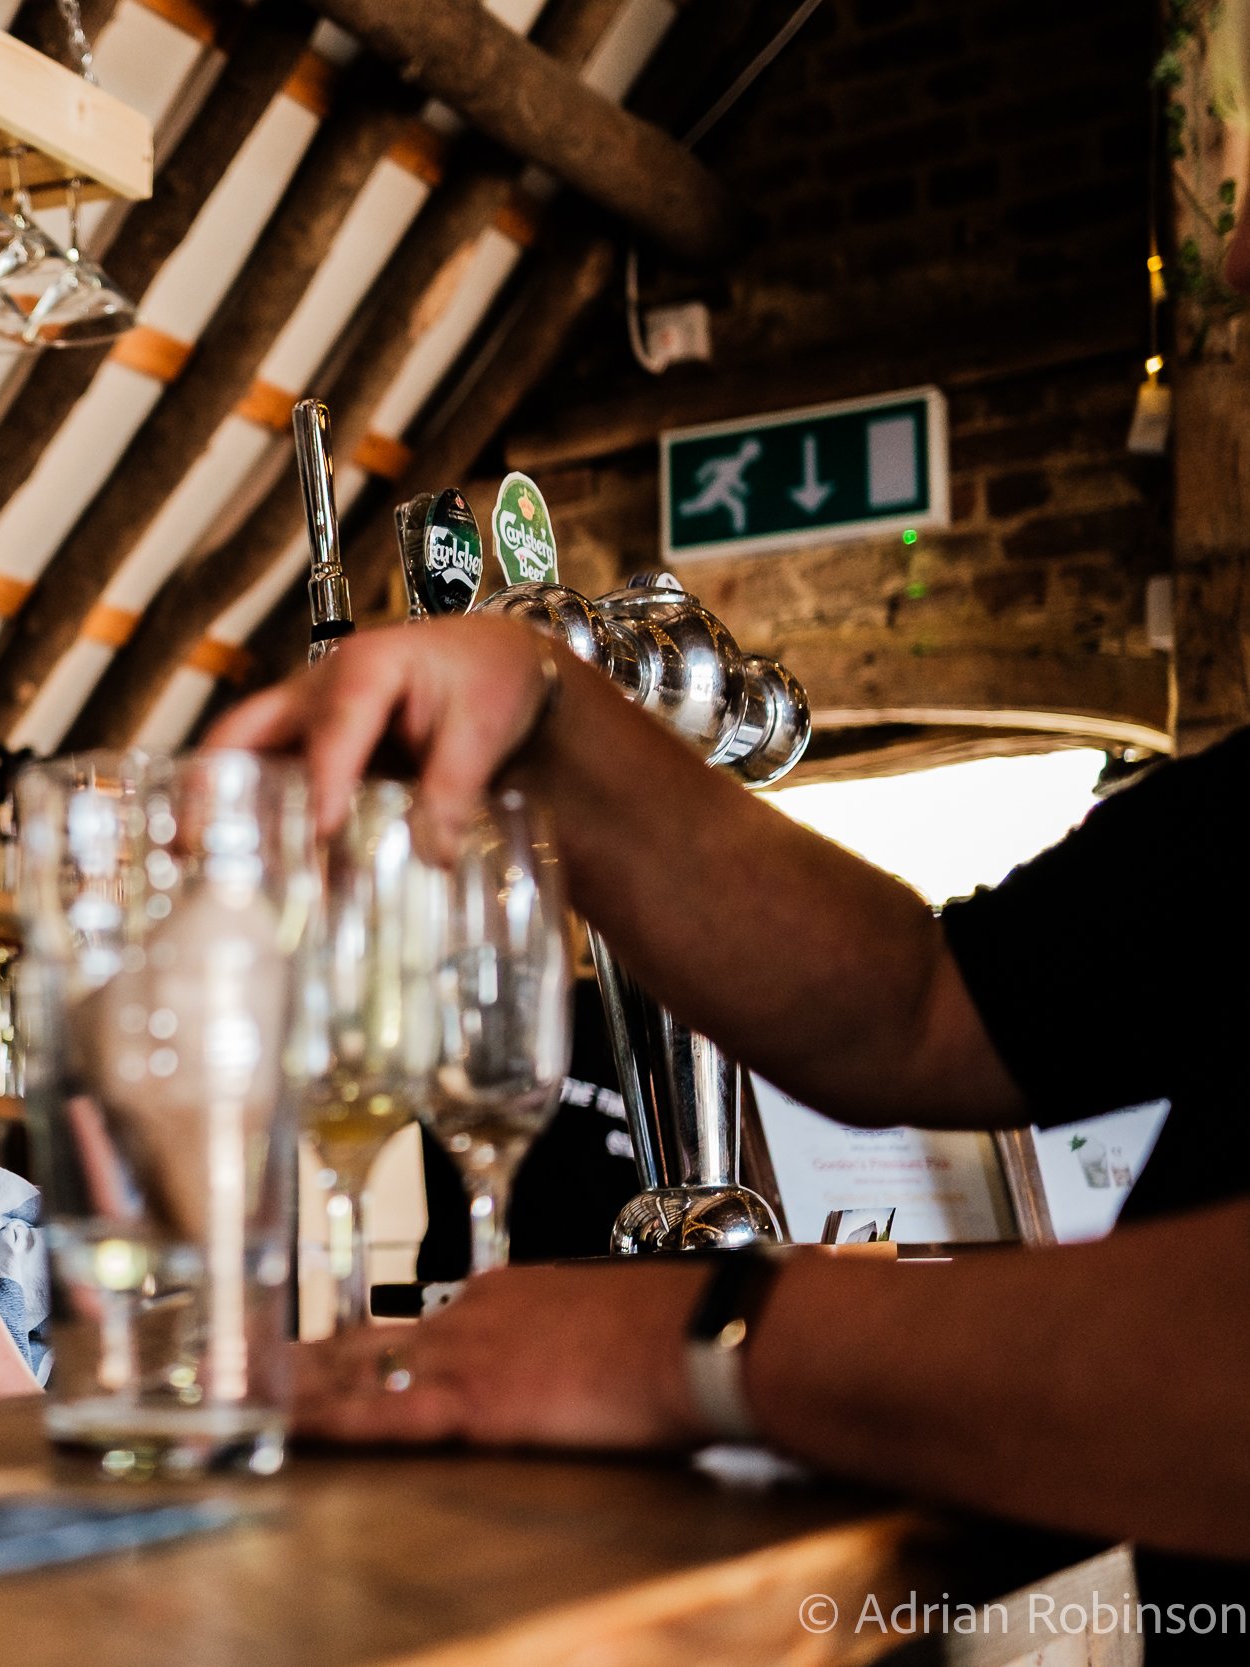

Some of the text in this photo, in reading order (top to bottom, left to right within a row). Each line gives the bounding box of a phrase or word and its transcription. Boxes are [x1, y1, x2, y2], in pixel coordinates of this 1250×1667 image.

[428, 525, 481, 577] Carlsber
[500, 510, 553, 568] Carlsberg
[519, 557, 545, 581] Beer
